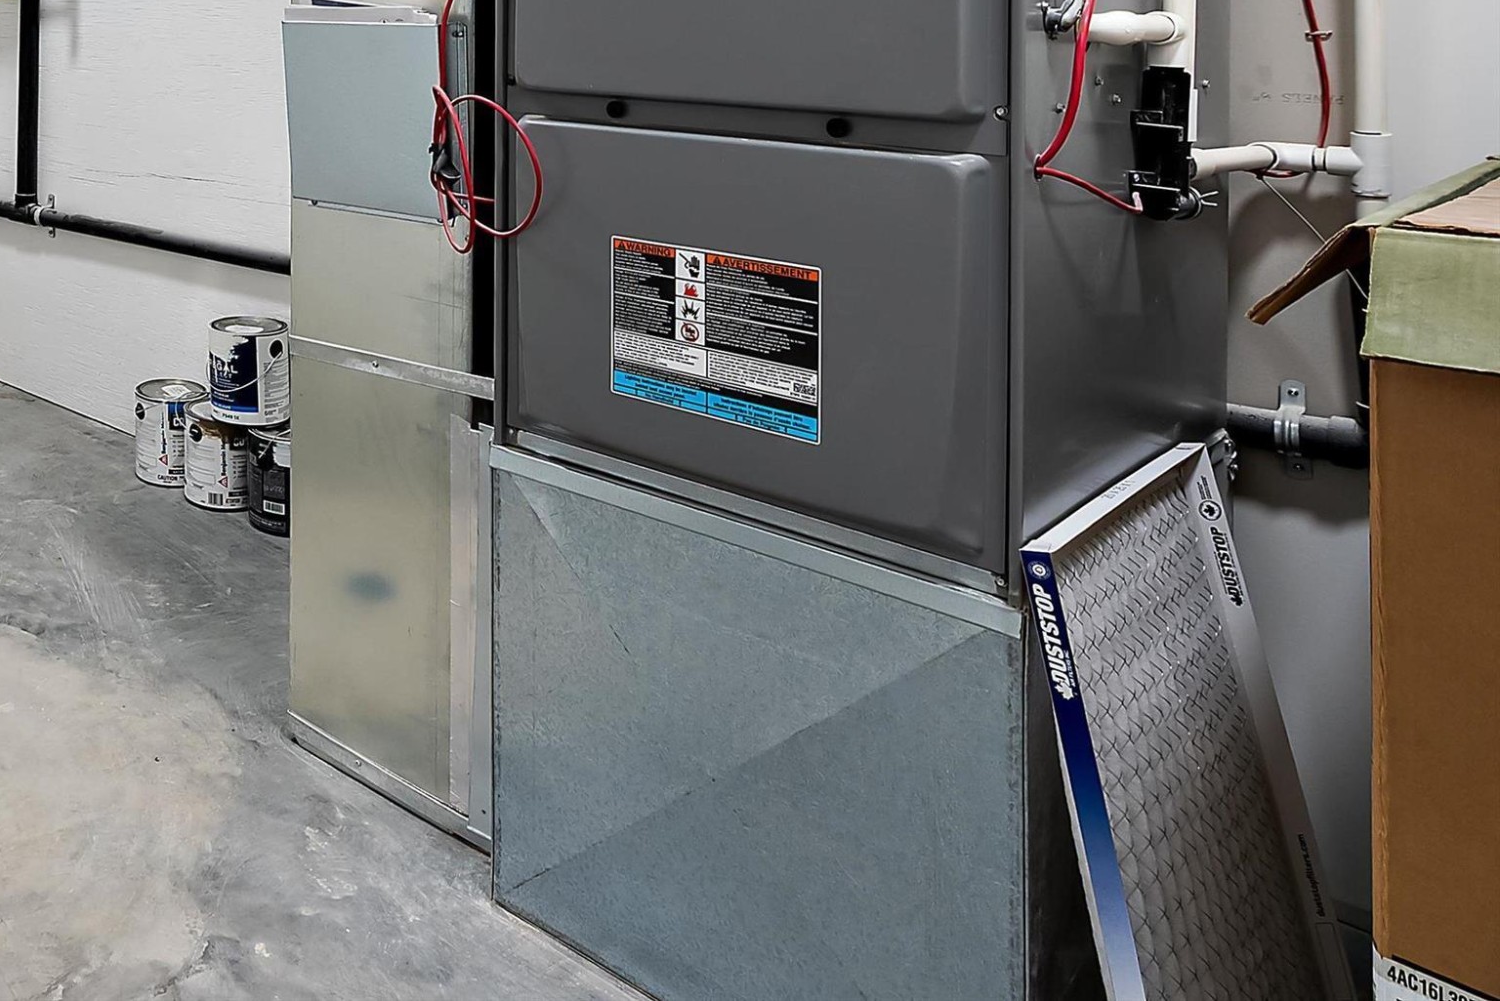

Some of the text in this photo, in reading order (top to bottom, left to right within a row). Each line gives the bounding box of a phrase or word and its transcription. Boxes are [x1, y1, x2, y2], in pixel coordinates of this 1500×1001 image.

[626, 242, 671, 257] WARNING
[722, 257, 812, 281] AVERTISSEMENT
[1210, 526, 1240, 597] DUSTSTOP
[1032, 582, 1071, 687] DUSTSTOP
